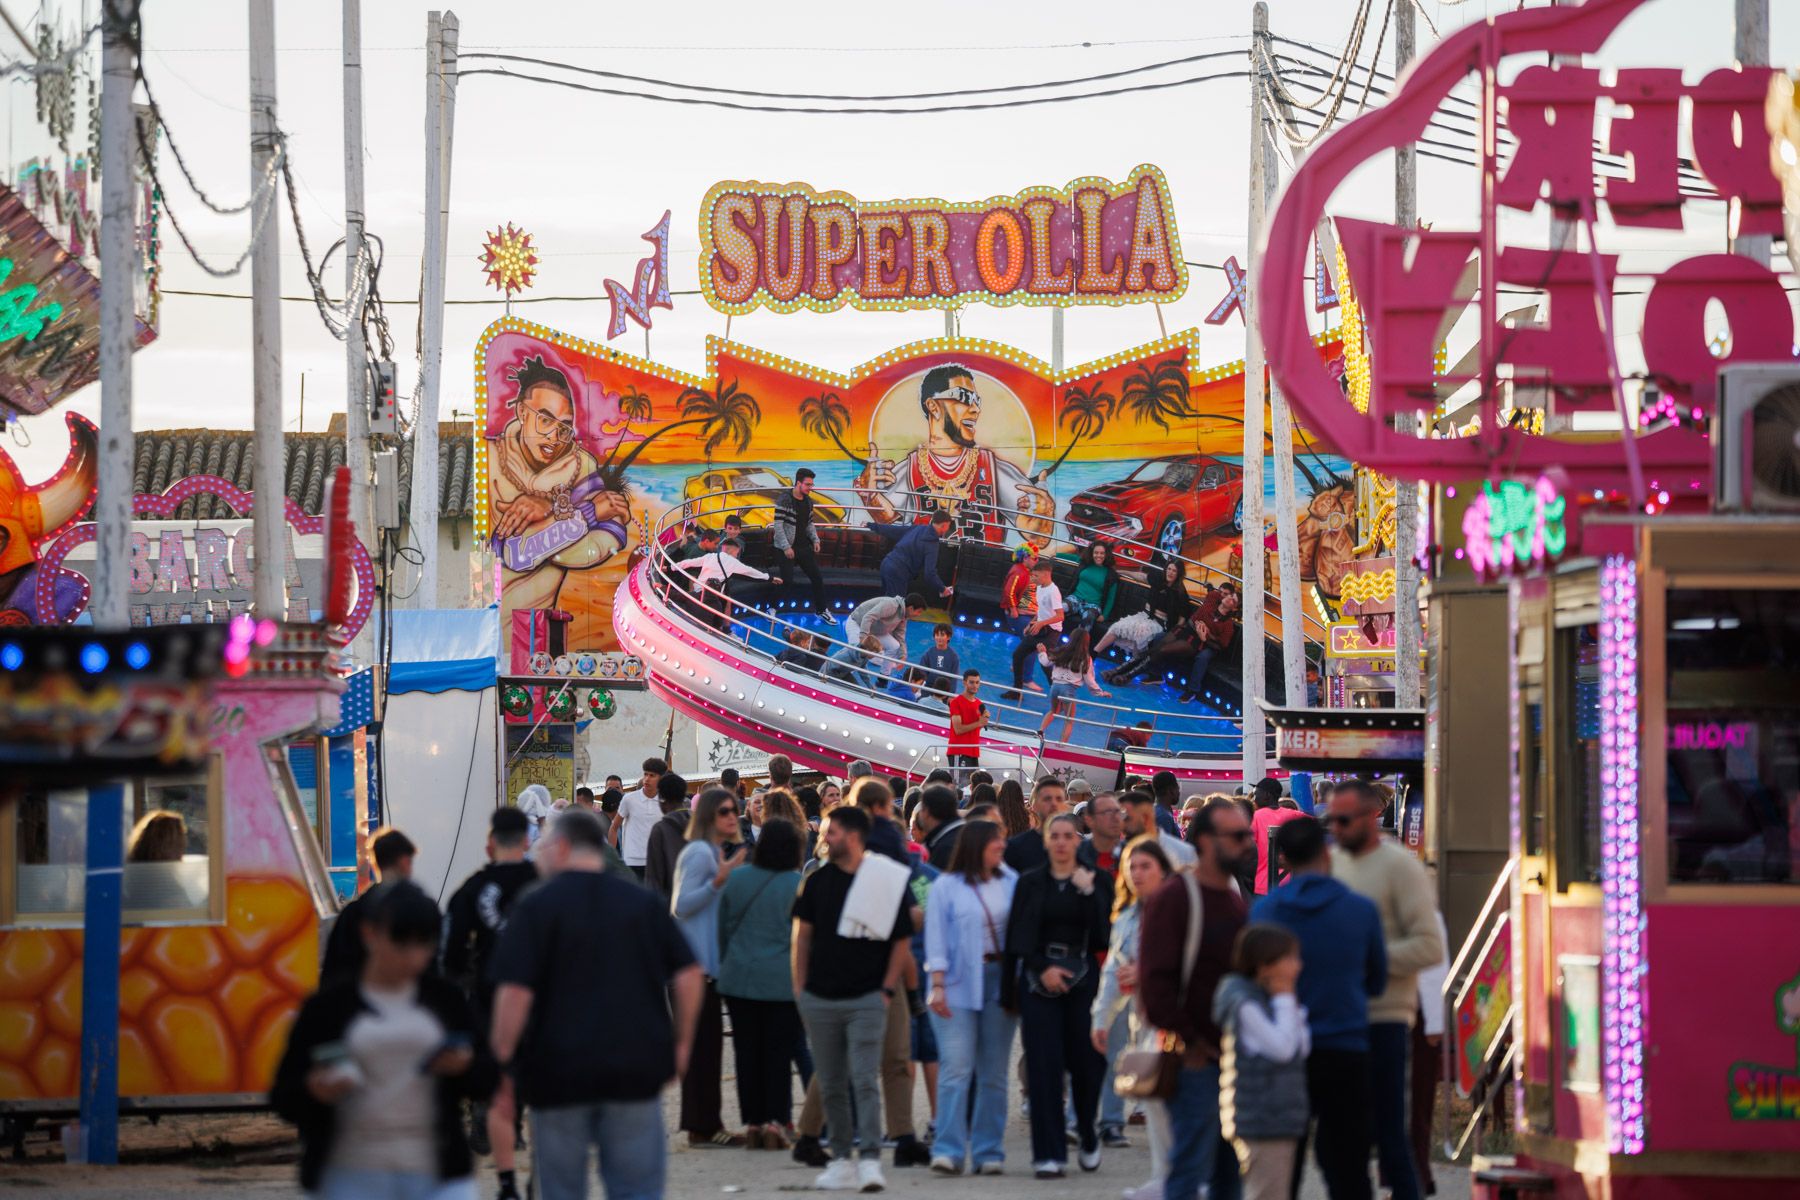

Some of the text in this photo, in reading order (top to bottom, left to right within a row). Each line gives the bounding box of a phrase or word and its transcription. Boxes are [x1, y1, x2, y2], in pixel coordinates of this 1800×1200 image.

[711, 175, 1181, 302] SUPER OLLA
[505, 510, 588, 571] LAKERS
[521, 766, 561, 778] PREMIO
[1409, 807, 1421, 846] SPEED
